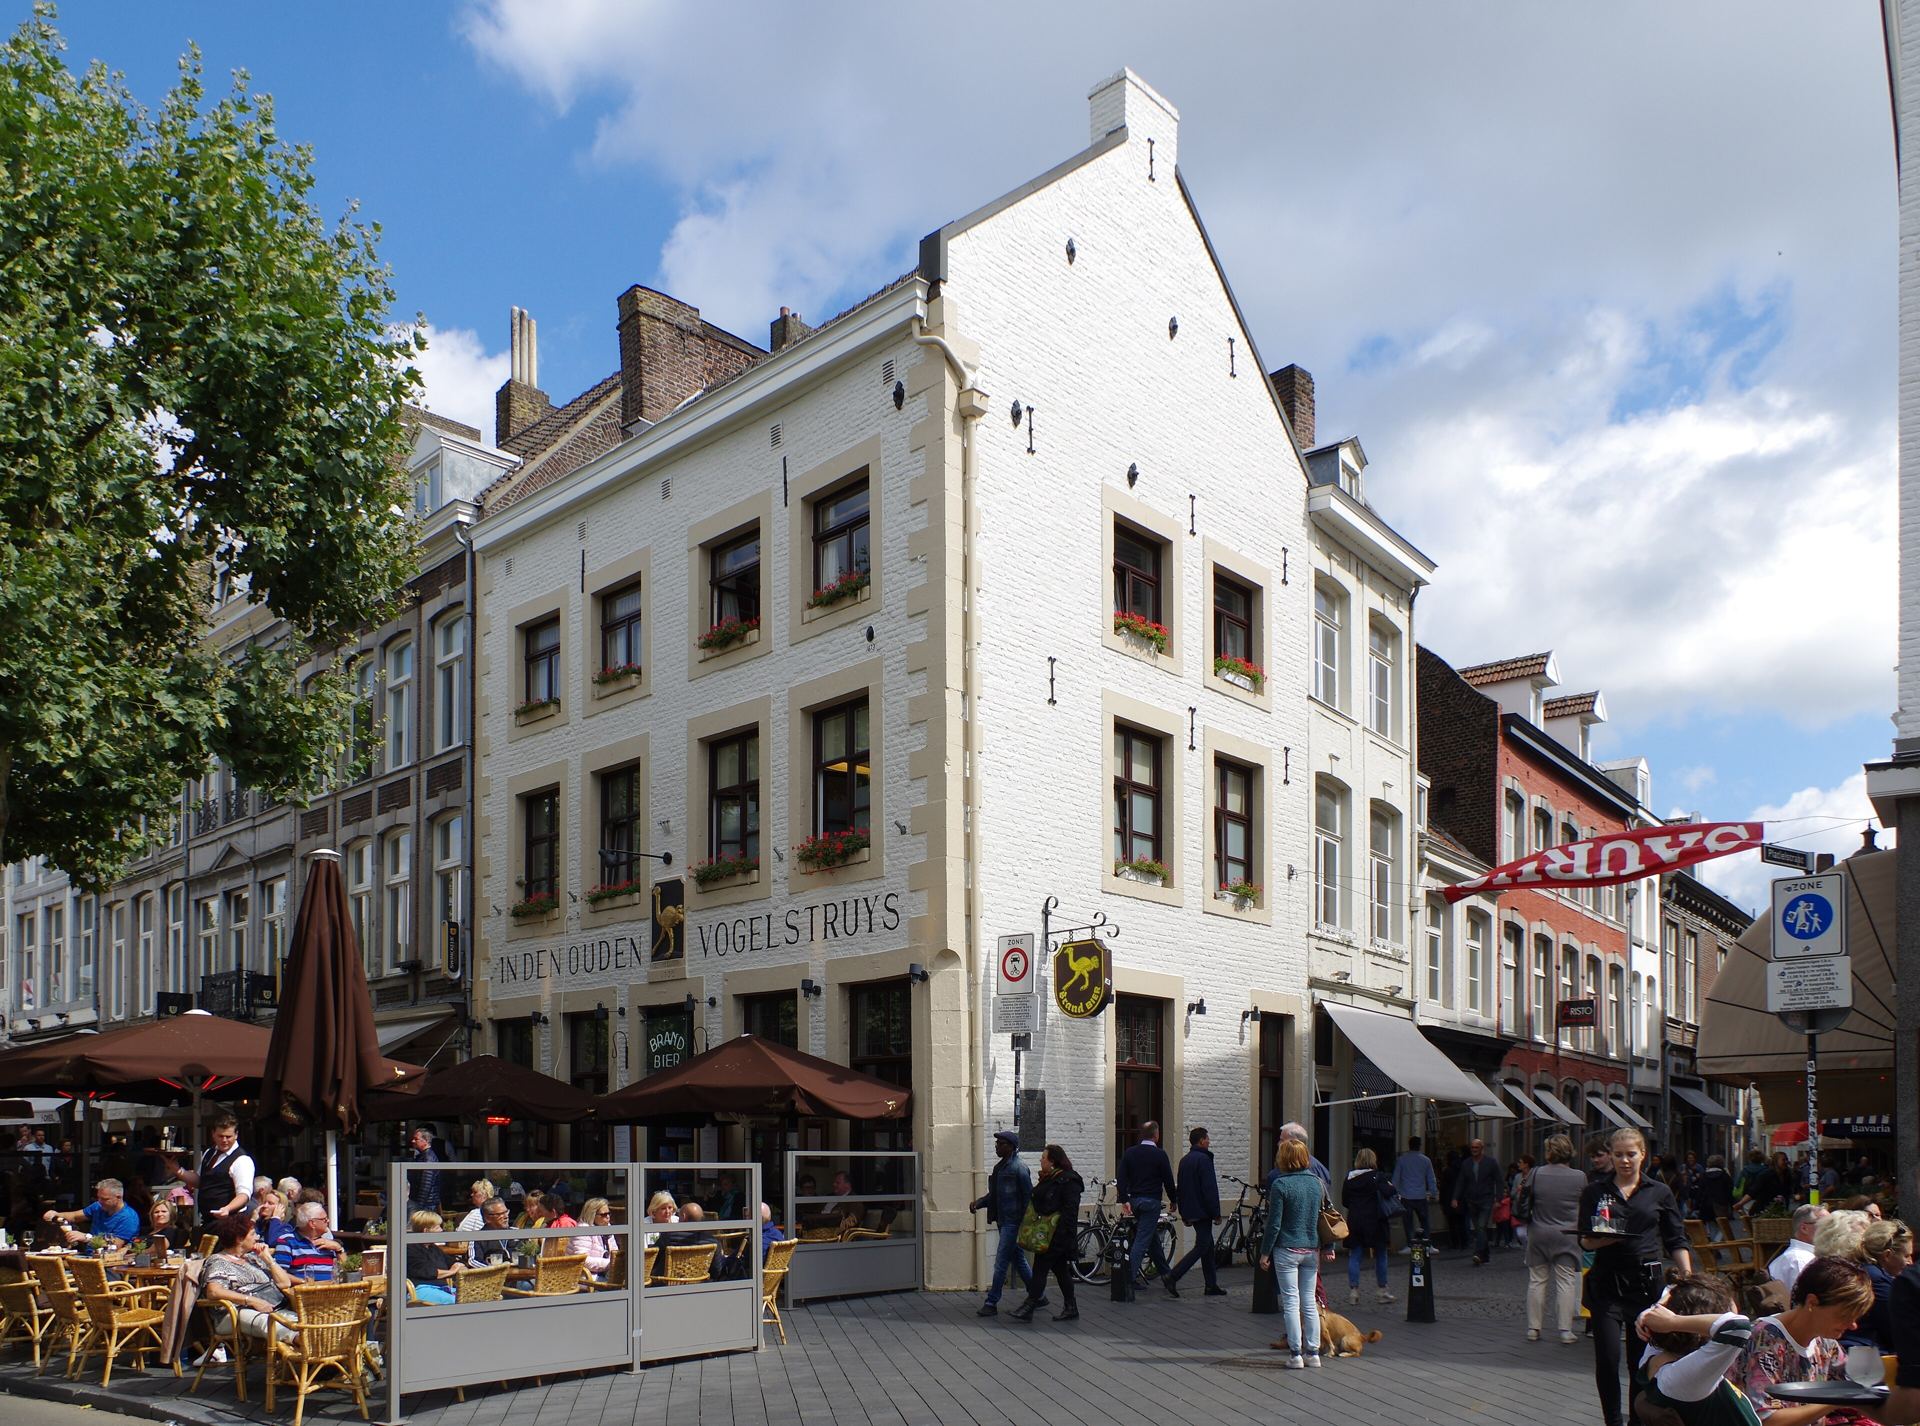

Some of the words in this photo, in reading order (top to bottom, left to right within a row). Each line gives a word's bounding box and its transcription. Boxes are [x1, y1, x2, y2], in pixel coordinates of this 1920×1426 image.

[1791, 880, 1823, 891] ZONE
[499, 954, 518, 984] IN
[523, 947, 561, 981] DEN
[568, 935, 642, 975] OUDEN
[697, 892, 900, 958] VOGELSTRUYS
[1007, 938, 1024, 946] ZONE
[1059, 990, 1085, 1013] Brand
[1085, 986, 1101, 1010] BIER
[649, 1031, 685, 1052] BRAND
[653, 1053, 680, 1069] BIER
[1851, 1124, 1891, 1133] Bavaria
